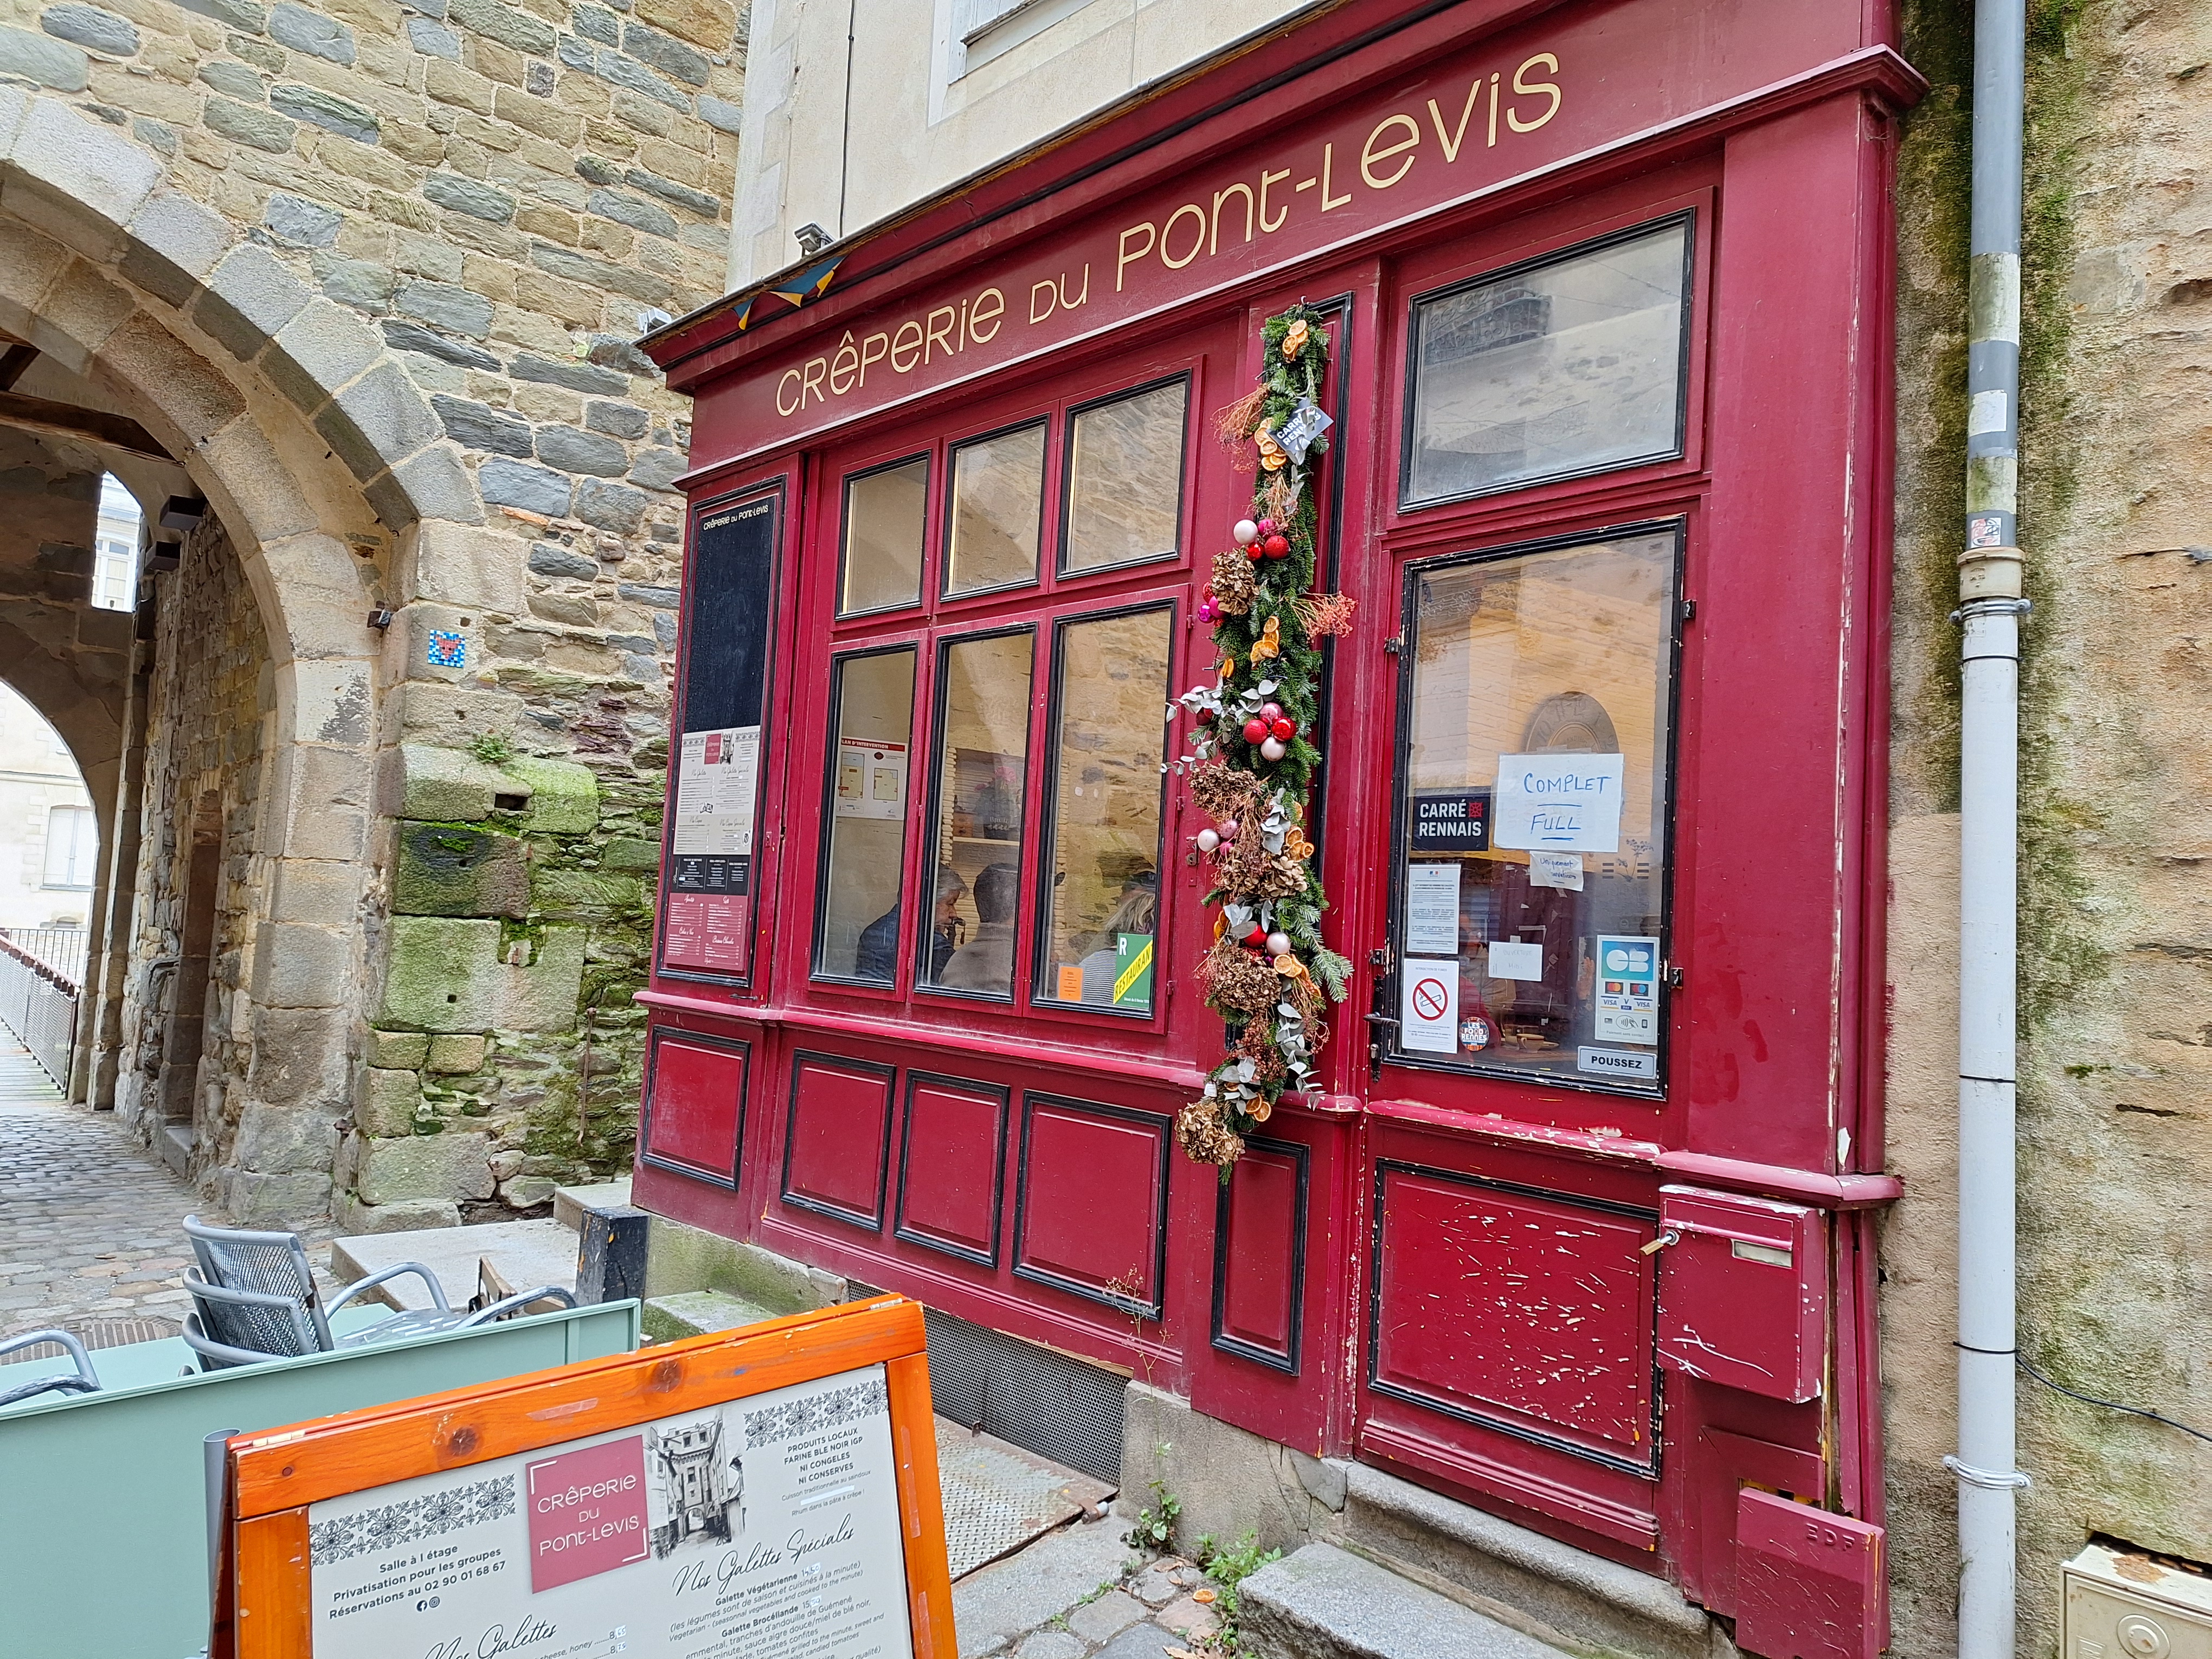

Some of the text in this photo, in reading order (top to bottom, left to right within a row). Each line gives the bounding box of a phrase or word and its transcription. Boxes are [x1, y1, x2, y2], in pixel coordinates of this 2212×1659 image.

[852, 741, 889, 749] D'INTERVENTION
[1524, 773, 1612, 794] COMPLET
[1420, 799, 1466, 818] CARRÉ
[1419, 821, 1482, 837] RENNAIS
[1531, 813, 1581, 834] FULL
[1119, 937, 1128, 956] R
[1461, 1033, 1487, 1041] RENNES
[1591, 1056, 1643, 1069] POUSSEZ
[784, 1436, 863, 1465] FARINE BLE NOIR IGP
[787, 1427, 858, 1454] PRODUITS LOCAUX
[798, 1462, 854, 1485] NI CONSERVES
[800, 1451, 850, 1472] NI CONGELES
[781, 1490, 803, 1501] Cuisson
[804, 1480, 840, 1495] traditionnelle
[848, 1469, 871, 1481] saindoux
[792, 1507, 808, 1516] Rhum
[809, 1503, 822, 1512] dans
[829, 1496, 841, 1506] pâte
[847, 1490, 861, 1500] crêpe
[1806, 1523, 1855, 1551] EDF
[380, 1559, 407, 1573] Salle
[410, 1555, 417, 1565] à
[427, 1545, 458, 1560] étage
[672, 1513, 854, 1597] Nos Galettes Spéciales
[333, 1548, 501, 1603] Privatisation pour les groupes
[715, 1591, 744, 1606] Galette
[747, 1572, 798, 1595] Végétarienne
[329, 1560, 506, 1620] Réservations au 02 90 01 68 67
[670, 1622, 685, 1633] (les
[687, 1609, 721, 1626] légumes
[723, 1604, 740, 1615] sont
[742, 1599, 752, 1608] de
[754, 1591, 777, 1604] saison
[779, 1586, 787, 1596] et
[788, 1577, 817, 1592] cuisinés
[825, 1570, 832, 1579] la
[833, 1560, 861, 1577] minute)
[669, 1624, 706, 1642] Vegetarian
[712, 1609, 747, 1629] (seasonnal
[749, 1598, 783, 1615] vegetables
[784, 1592, 796, 1602] and
[797, 1586, 820, 1598] cooked
[829, 1578, 839, 1587] the
[840, 1570, 863, 1583] minute)
[686, 1595, 853, 1659] emmental, tranches d'andouille de Guémené
[722, 1623, 751, 1638] Galette
[753, 1604, 799, 1626] Brocéliande
[744, 1636, 767, 1650] sauce
[768, 1629, 788, 1644] aigre
[789, 1612, 831, 1635] douce/miel
[832, 1609, 841, 1618] de
[843, 1604, 854, 1615] blé
[856, 1599, 871, 1611] noir,
[790, 1639, 811, 1654] grilled
[819, 1631, 829, 1642] the
[831, 1625, 853, 1638] minute,
[854, 1618, 872, 1630] sweet
[873, 1612, 884, 1622] and
[478, 1614, 557, 1659] Galettes
[569, 1639, 593, 1654] honey
[756, 1639, 787, 1656] tomates
[789, 1627, 819, 1644] confites
[806, 1641, 830, 1657] candied
[831, 1631, 860, 1648] tomatoes
